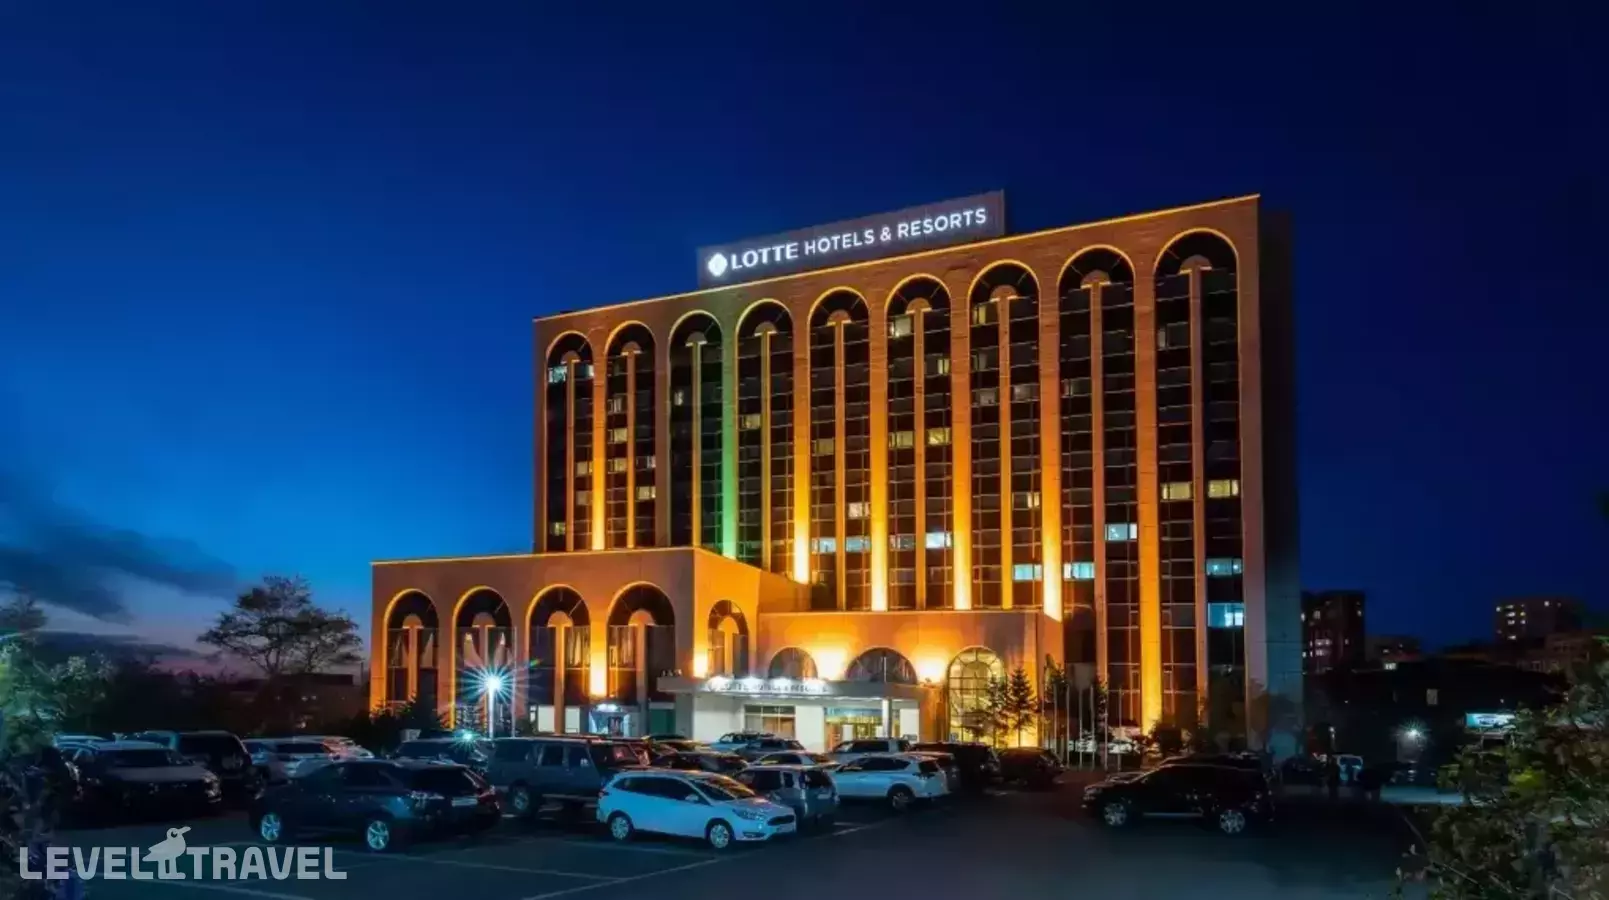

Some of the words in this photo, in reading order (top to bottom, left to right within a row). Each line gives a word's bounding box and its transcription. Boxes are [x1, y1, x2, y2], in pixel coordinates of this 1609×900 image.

[731, 242, 799, 270] LOTTE
[804, 229, 875, 255] HOTELS
[880, 227, 892, 242] &
[898, 208, 986, 238] RESORTS
